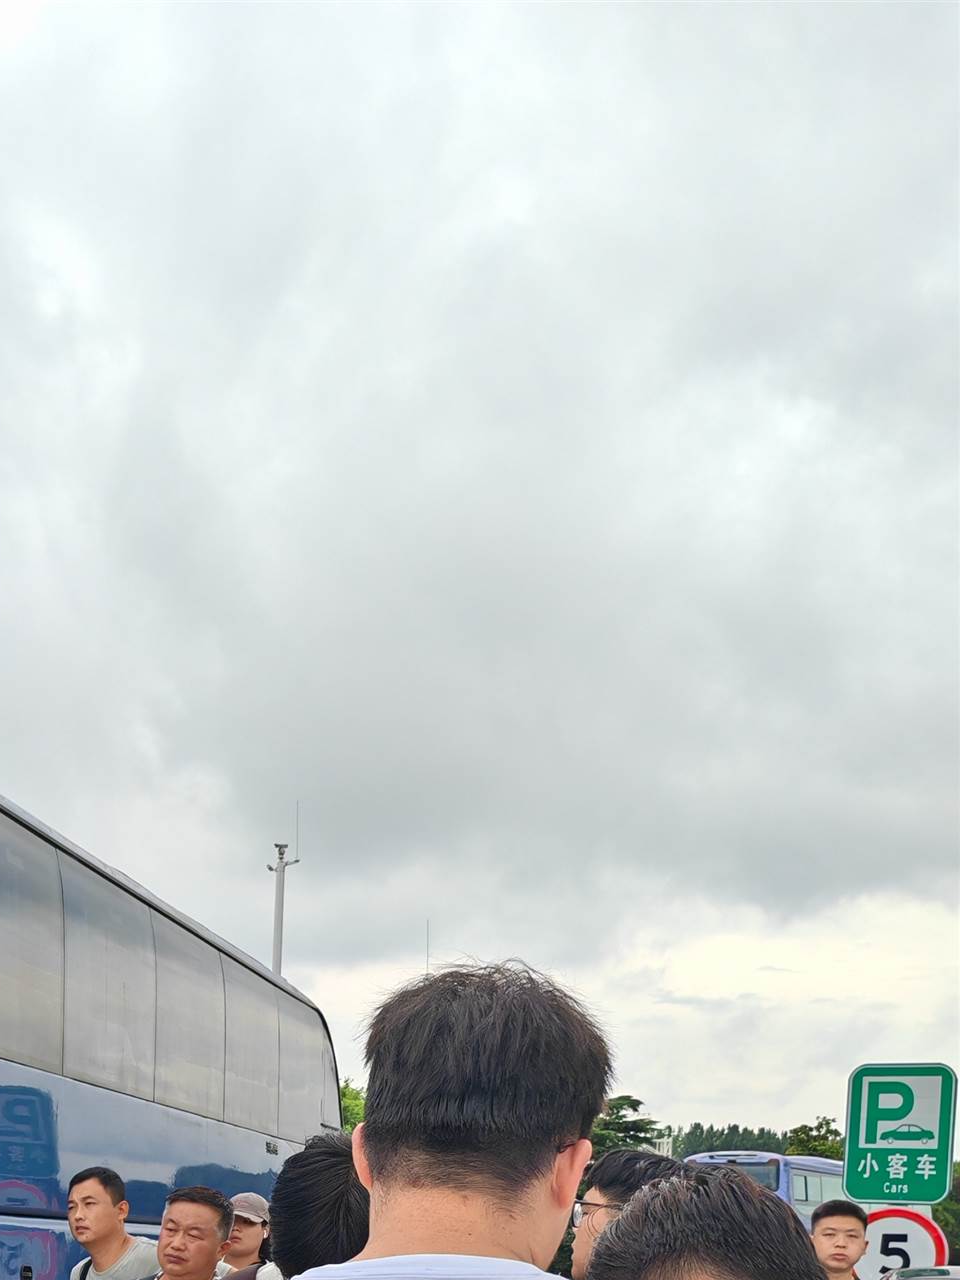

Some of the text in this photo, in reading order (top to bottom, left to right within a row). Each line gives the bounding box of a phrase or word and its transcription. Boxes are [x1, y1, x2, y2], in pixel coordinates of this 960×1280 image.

[864, 1081, 915, 1145] P
[857, 1152, 937, 1180] 小客车
[883, 1182, 909, 1194] Cars
[879, 1233, 911, 1275] 5
